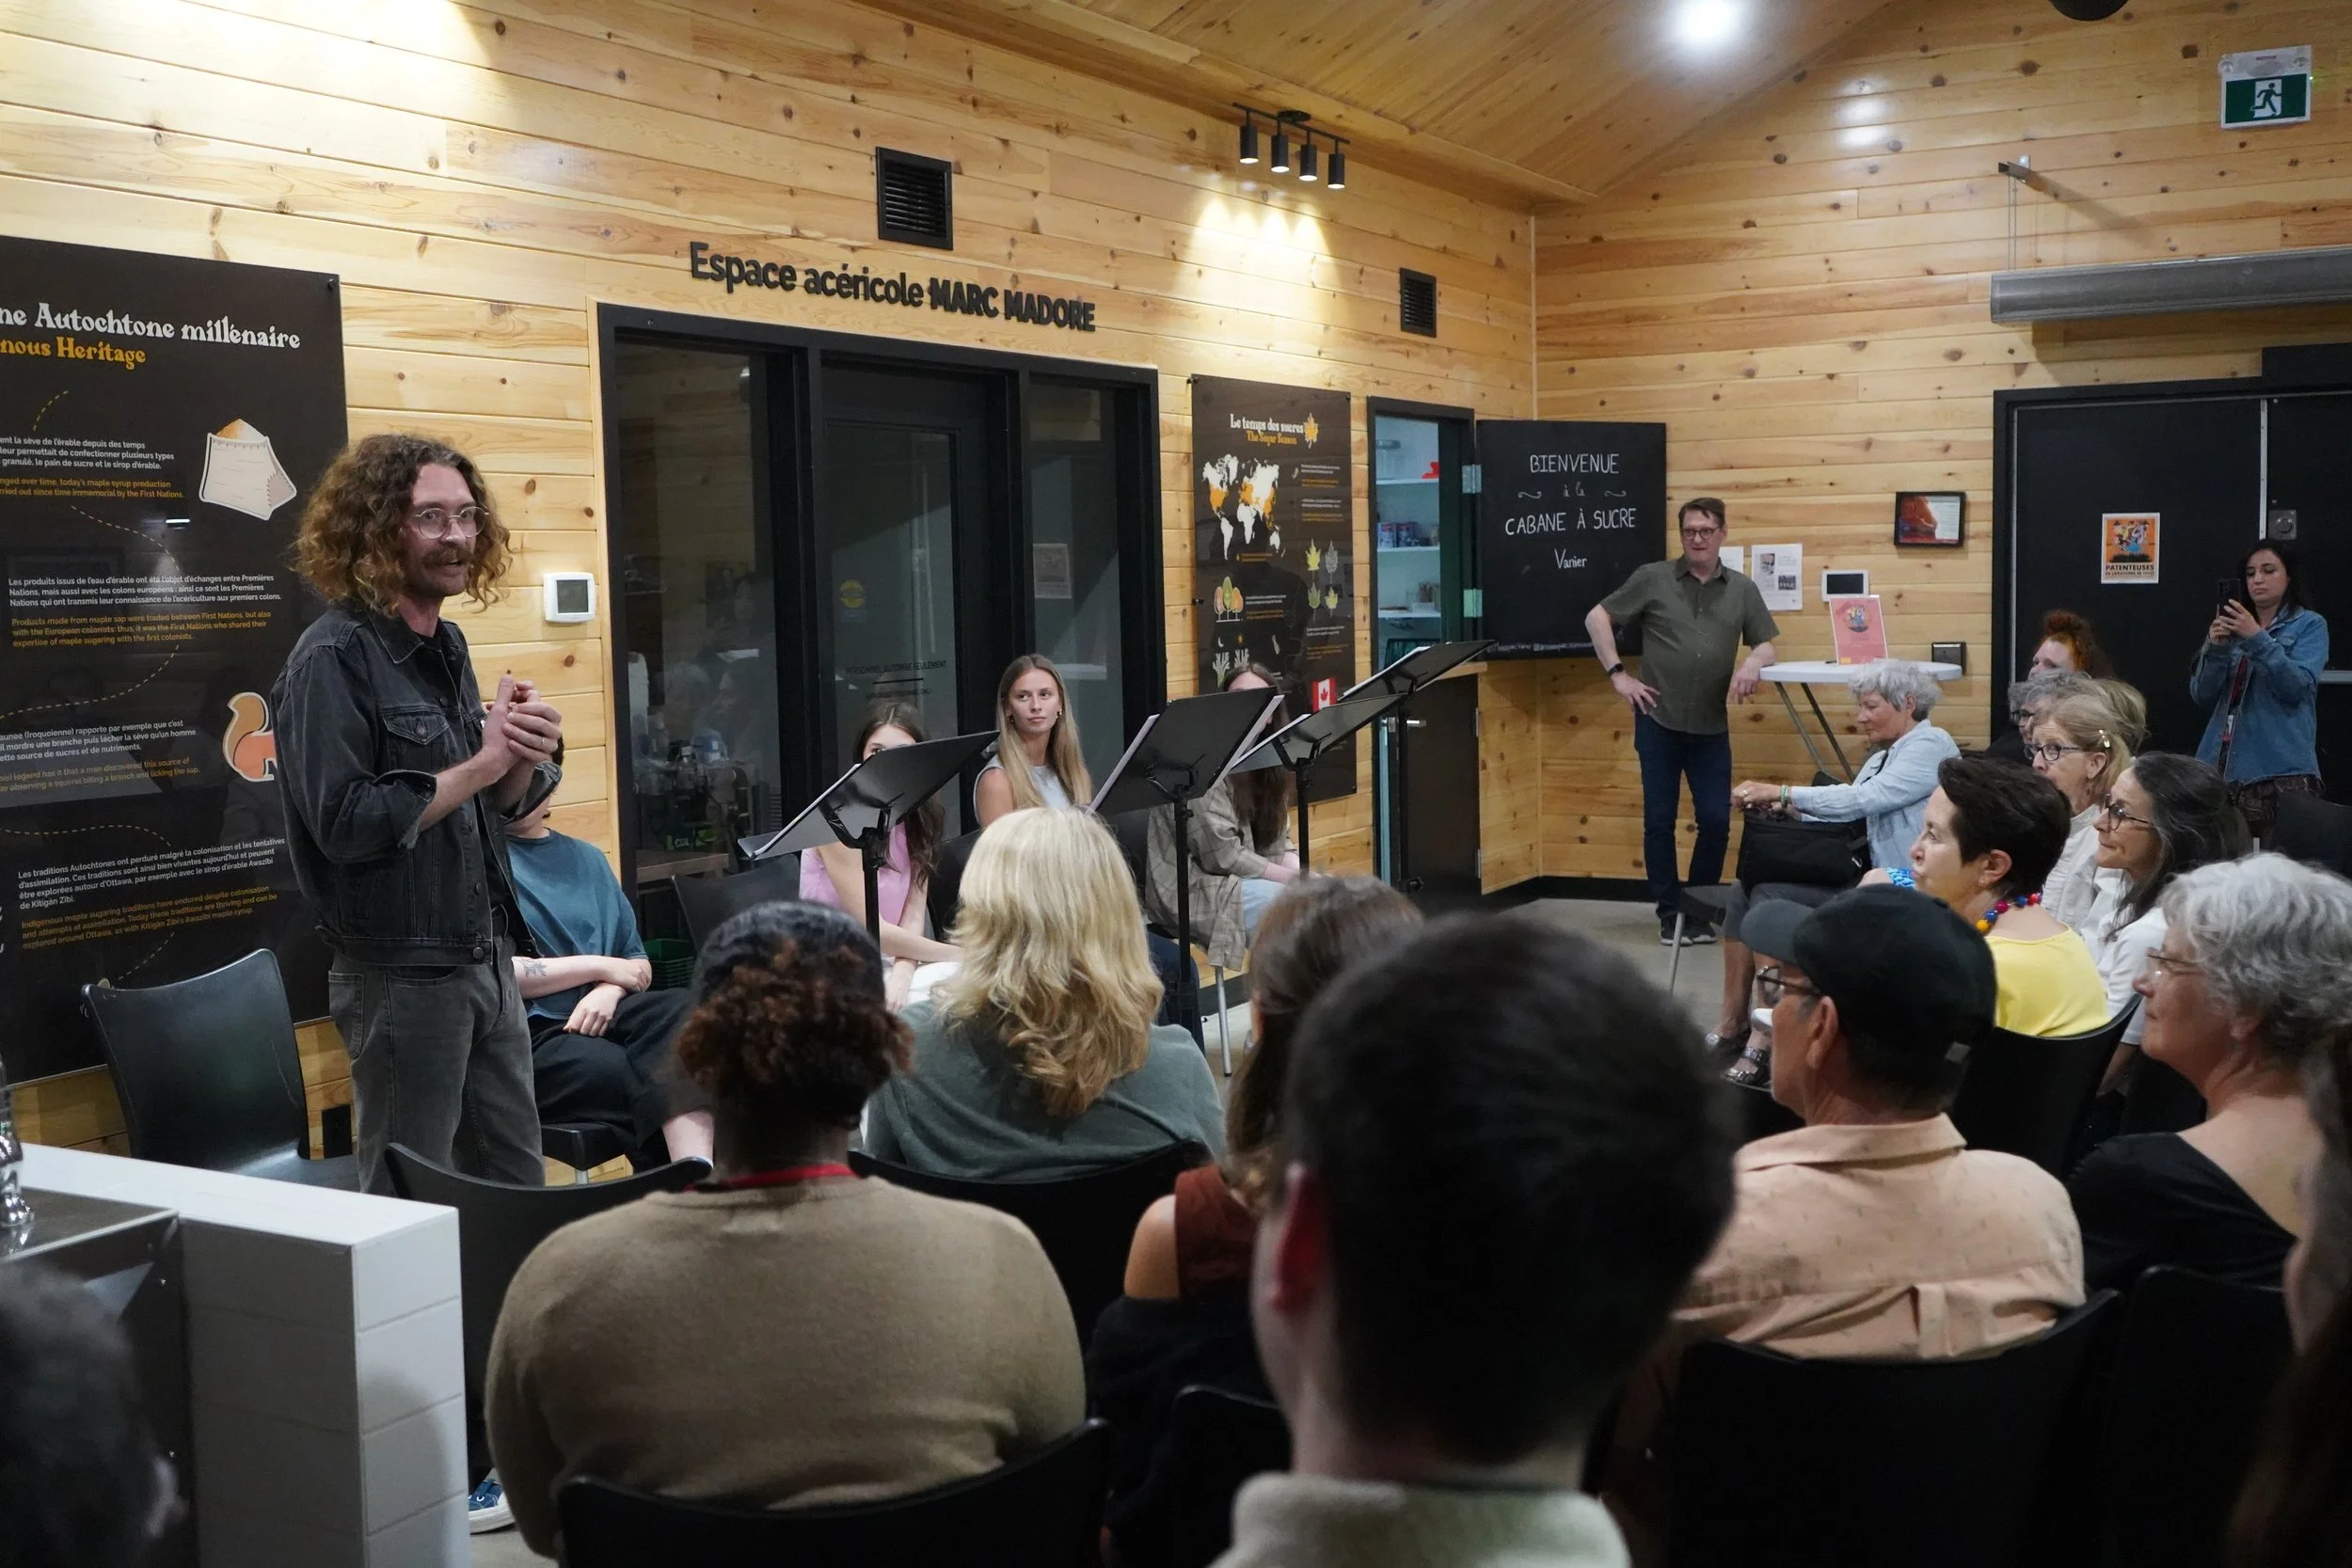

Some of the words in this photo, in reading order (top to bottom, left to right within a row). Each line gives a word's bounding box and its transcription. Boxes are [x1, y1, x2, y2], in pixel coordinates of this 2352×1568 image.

[690, 241, 797, 293] Espace
[803, 263, 924, 308] acéricole
[930, 277, 999, 318] MARC
[1003, 289, 1096, 332] MADORE
[34, 302, 175, 339] Autochtone
[181, 315, 301, 349] millénaire
[56, 336, 146, 370] Heritage
[1230, 413, 1241, 428] Le
[1242, 417, 1266, 435] temps
[1267, 417, 1279, 431] des
[1280, 423, 1303, 433] sucres
[82, 440, 107, 449] depuis
[122, 441, 146, 450] temps
[44, 459, 60, 468] pain
[113, 461, 131, 470] sirop
[122, 451, 154, 460] plusieurs
[155, 452, 175, 461] types
[1530, 454, 1619, 474] BIENVENUE
[1576, 482, 1585, 497] la
[1505, 512, 1566, 535] CABANE
[1577, 508, 1586, 530] À
[1593, 508, 1637, 530] SUCRE
[1554, 548, 1587, 569] Vanier
[24, 577, 55, 587] produits
[40, 598, 52, 607] qui
[67, 597, 98, 605] transmis
[230, 593, 258, 602] premiers
[24, 728, 74, 739] (Iroquoienne)
[76, 726, 107, 736] rapporte
[108, 726, 120, 734] par
[122, 722, 152, 731] exemple
[153, 722, 167, 731] que
[6, 741, 35, 750] mordre
[52, 737, 82, 746] branche
[84, 736, 100, 745] puis
[33, 866, 69, 877] traditions
[70, 860, 116, 872] Autochtones
[117, 857, 129, 866] ont
[130, 853, 159, 866] perduré
[160, 850, 184, 860] malgré
[193, 845, 233, 856] colonisation
[253, 838, 285, 848] tentatives
[87, 870, 122, 880] traditions
[123, 866, 138, 875] sont
[140, 864, 156, 873] ainsi
[172, 859, 201, 869] vivantes
[248, 849, 275, 860] peuvent
[36, 886, 73, 897] explorées
[75, 883, 98, 891] autour
[135, 876, 147, 885] par
[148, 871, 177, 881] exemple
